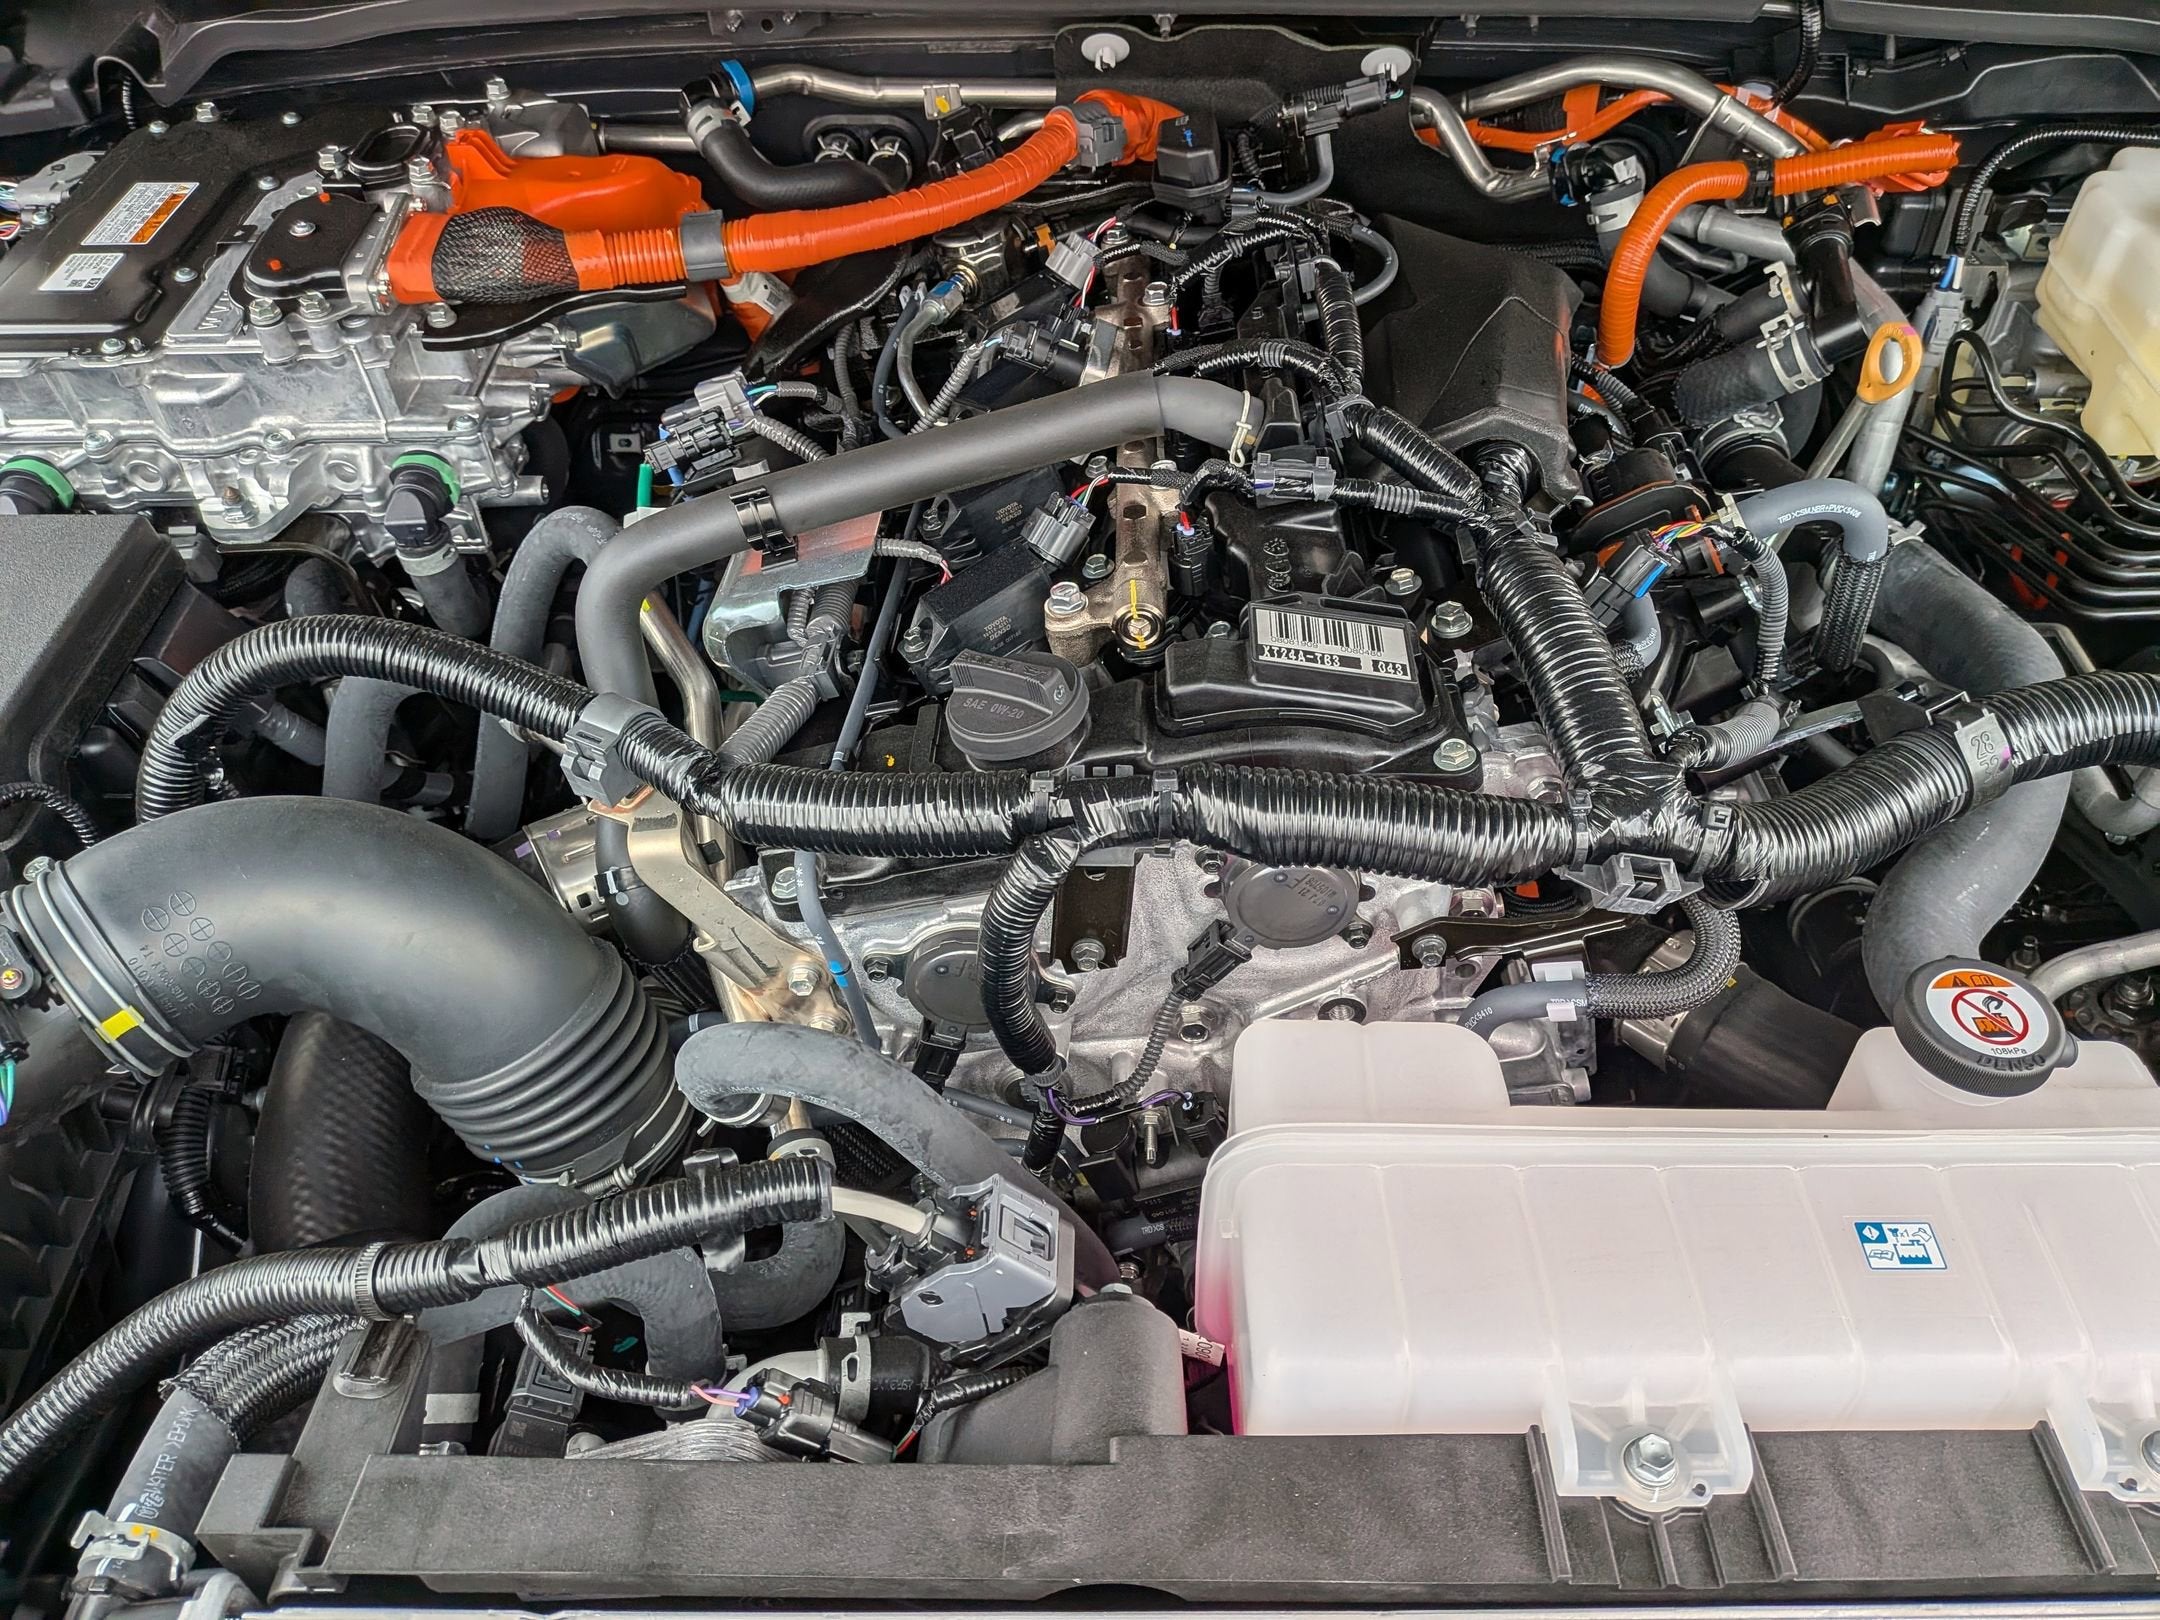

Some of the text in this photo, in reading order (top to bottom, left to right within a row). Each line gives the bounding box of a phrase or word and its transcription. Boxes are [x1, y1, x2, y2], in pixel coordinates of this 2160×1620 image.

[983, 615, 1009, 632] TOYOTA
[989, 624, 1011, 641] DENSO
[1262, 643, 1404, 676] XT24A-TB3 043
[962, 697, 1025, 720] SAE 0W-20
[1970, 730, 1996, 761] 28
[1990, 1047, 2028, 1056] 108kPa
[1975, 1052, 2047, 1073] DENSO
